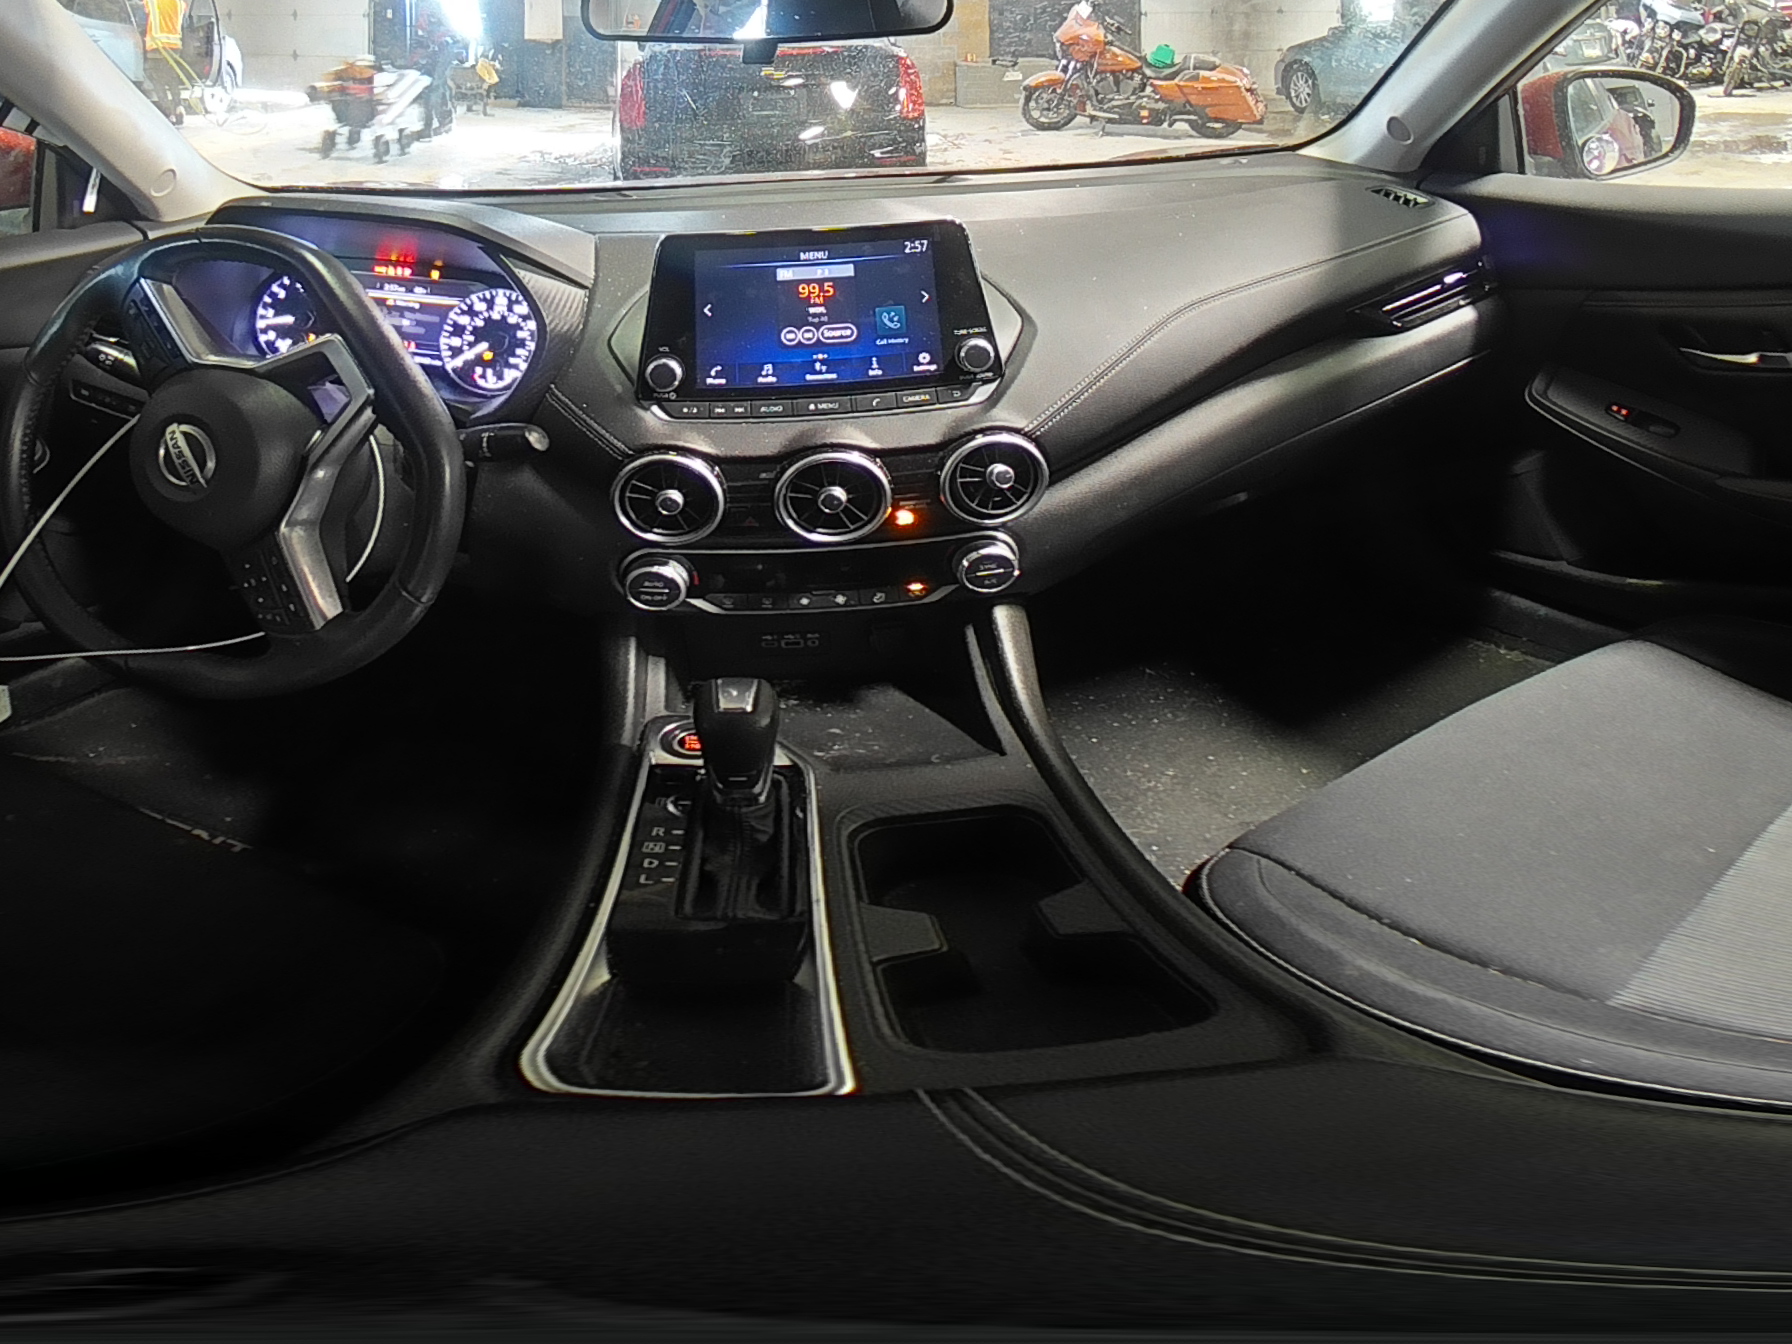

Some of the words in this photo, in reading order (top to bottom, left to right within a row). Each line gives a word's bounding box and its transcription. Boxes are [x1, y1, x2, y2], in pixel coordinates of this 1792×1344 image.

[904, 239, 928, 254] 2:57
[799, 250, 829, 261] MENU
[798, 281, 835, 298] 99.5
[823, 328, 853, 338] Source
[902, 394, 931, 403] CAMERA
[759, 405, 784, 414] AUDIO
[816, 401, 840, 410] MENU
[167, 428, 198, 486] NISSAN
[651, 826, 666, 837] R
[642, 857, 660, 869] D
[638, 873, 655, 885] L
